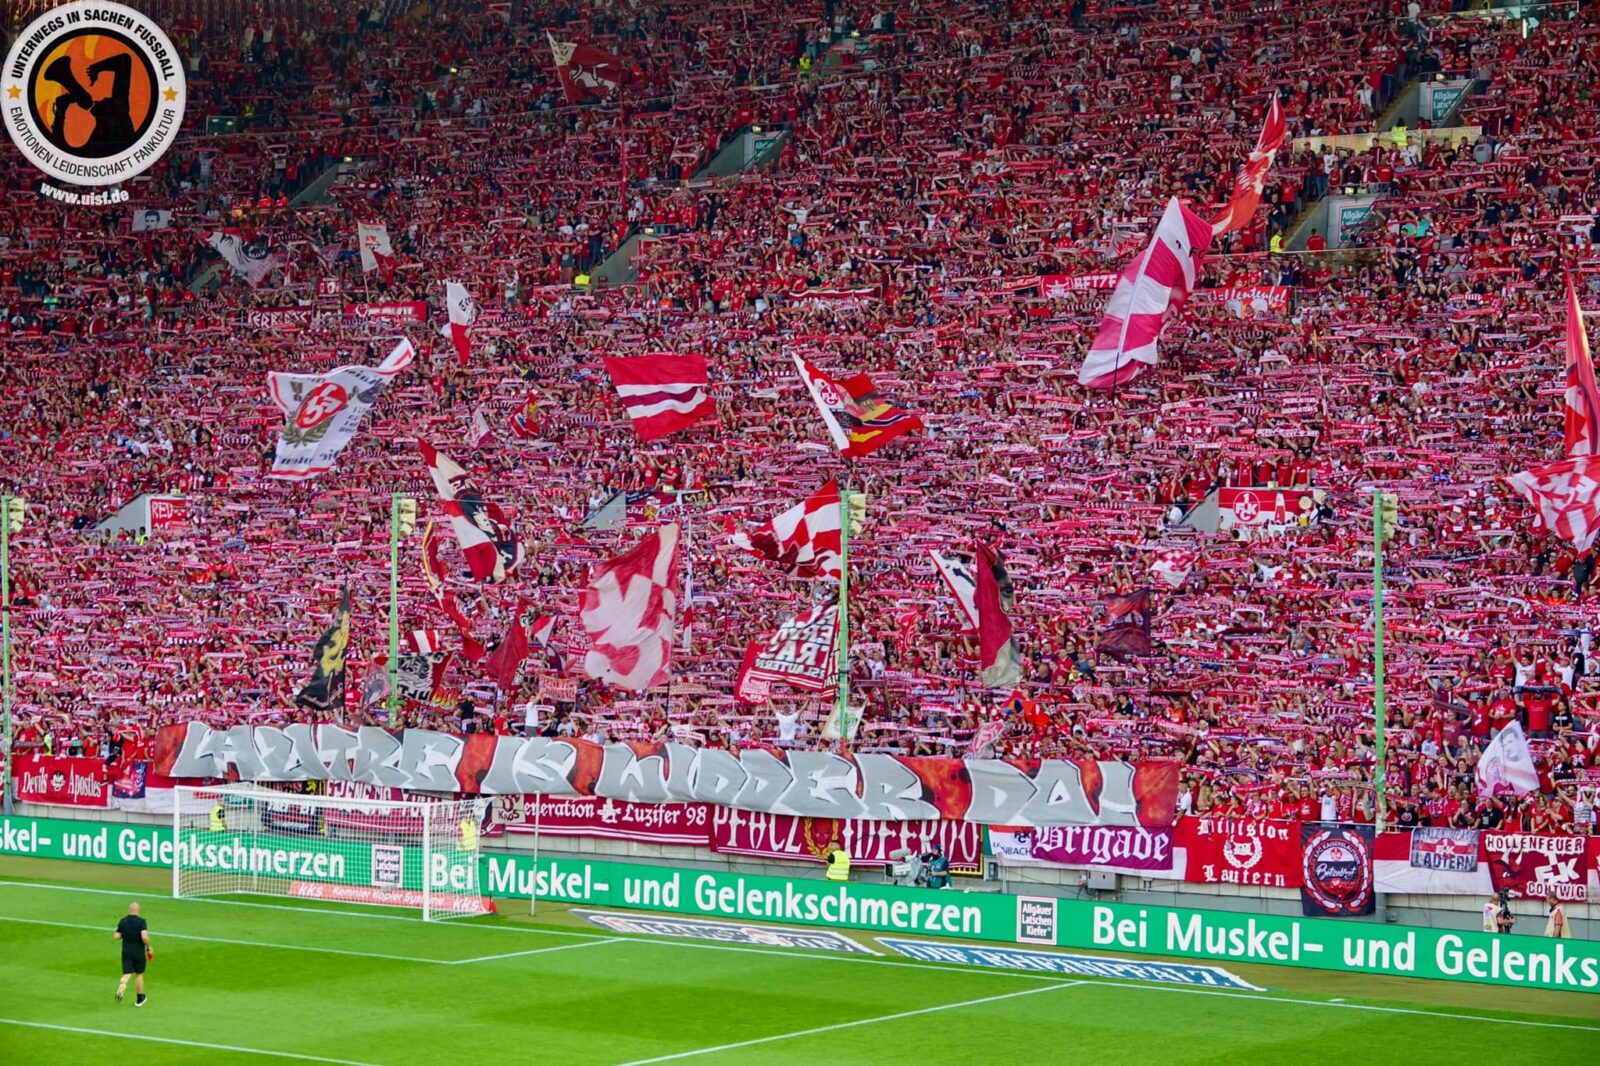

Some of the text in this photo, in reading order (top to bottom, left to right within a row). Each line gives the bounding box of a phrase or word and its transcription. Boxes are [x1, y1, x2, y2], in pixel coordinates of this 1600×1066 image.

[22, 766, 48, 794] Devils
[67, 763, 102, 803] Apostles
[171, 721, 462, 792] LAUTRE
[480, 736, 583, 797] IS
[595, 742, 941, 820] WIDDER
[524, 799, 595, 820] eneration
[622, 804, 682, 828] Luzifer
[684, 802, 707, 826] '98
[1031, 826, 1169, 864] Brigade
[1202, 864, 1286, 887] Lautern
[0, 819, 51, 853] kel-
[62, 826, 107, 859] und
[118, 828, 345, 879] Gelenkschmerzen
[431, 851, 475, 889] Bei
[488, 857, 610, 900] Muskel-
[623, 872, 680, 908] und
[694, 874, 982, 934] Gelenkschmerzen
[1093, 906, 1148, 948] Bei
[1166, 911, 1324, 961] Muskel-
[1343, 931, 1415, 971] und
[1022, 903, 1052, 916] Allgäuer
[1022, 914, 1052, 926] Latschen
